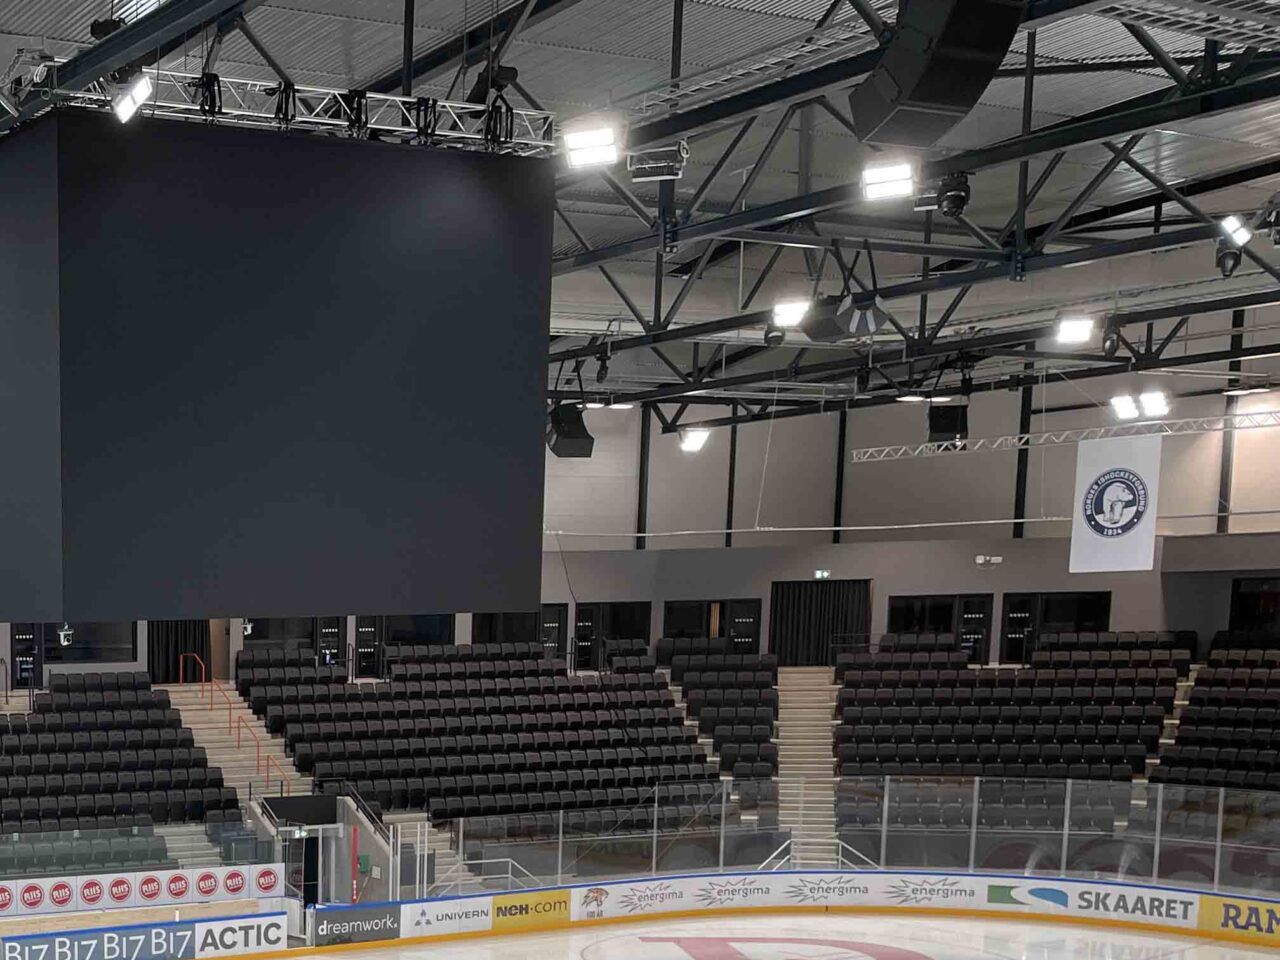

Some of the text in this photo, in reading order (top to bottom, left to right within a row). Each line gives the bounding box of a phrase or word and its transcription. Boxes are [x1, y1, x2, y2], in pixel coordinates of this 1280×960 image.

[23, 890, 42, 902] RIIS
[52, 888, 70, 900] RIIS
[83, 886, 101, 898] RIIS
[111, 884, 129, 896] RIIS
[141, 881, 159, 893] RIIS
[169, 880, 186, 891] RIIS
[198, 878, 216, 890] RIIS
[226, 876, 243, 888] RIIS
[258, 874, 276, 886] RIIS
[717, 886, 770, 898] energima
[809, 884, 869, 897] energima
[911, 886, 975, 899] energima
[637, 890, 684, 903] energima
[1077, 890, 1194, 920] SKAARET
[435, 908, 489, 922] UNIVERN
[318, 914, 398, 936] dreamwork.
[198, 922, 282, 952] ACTIC
